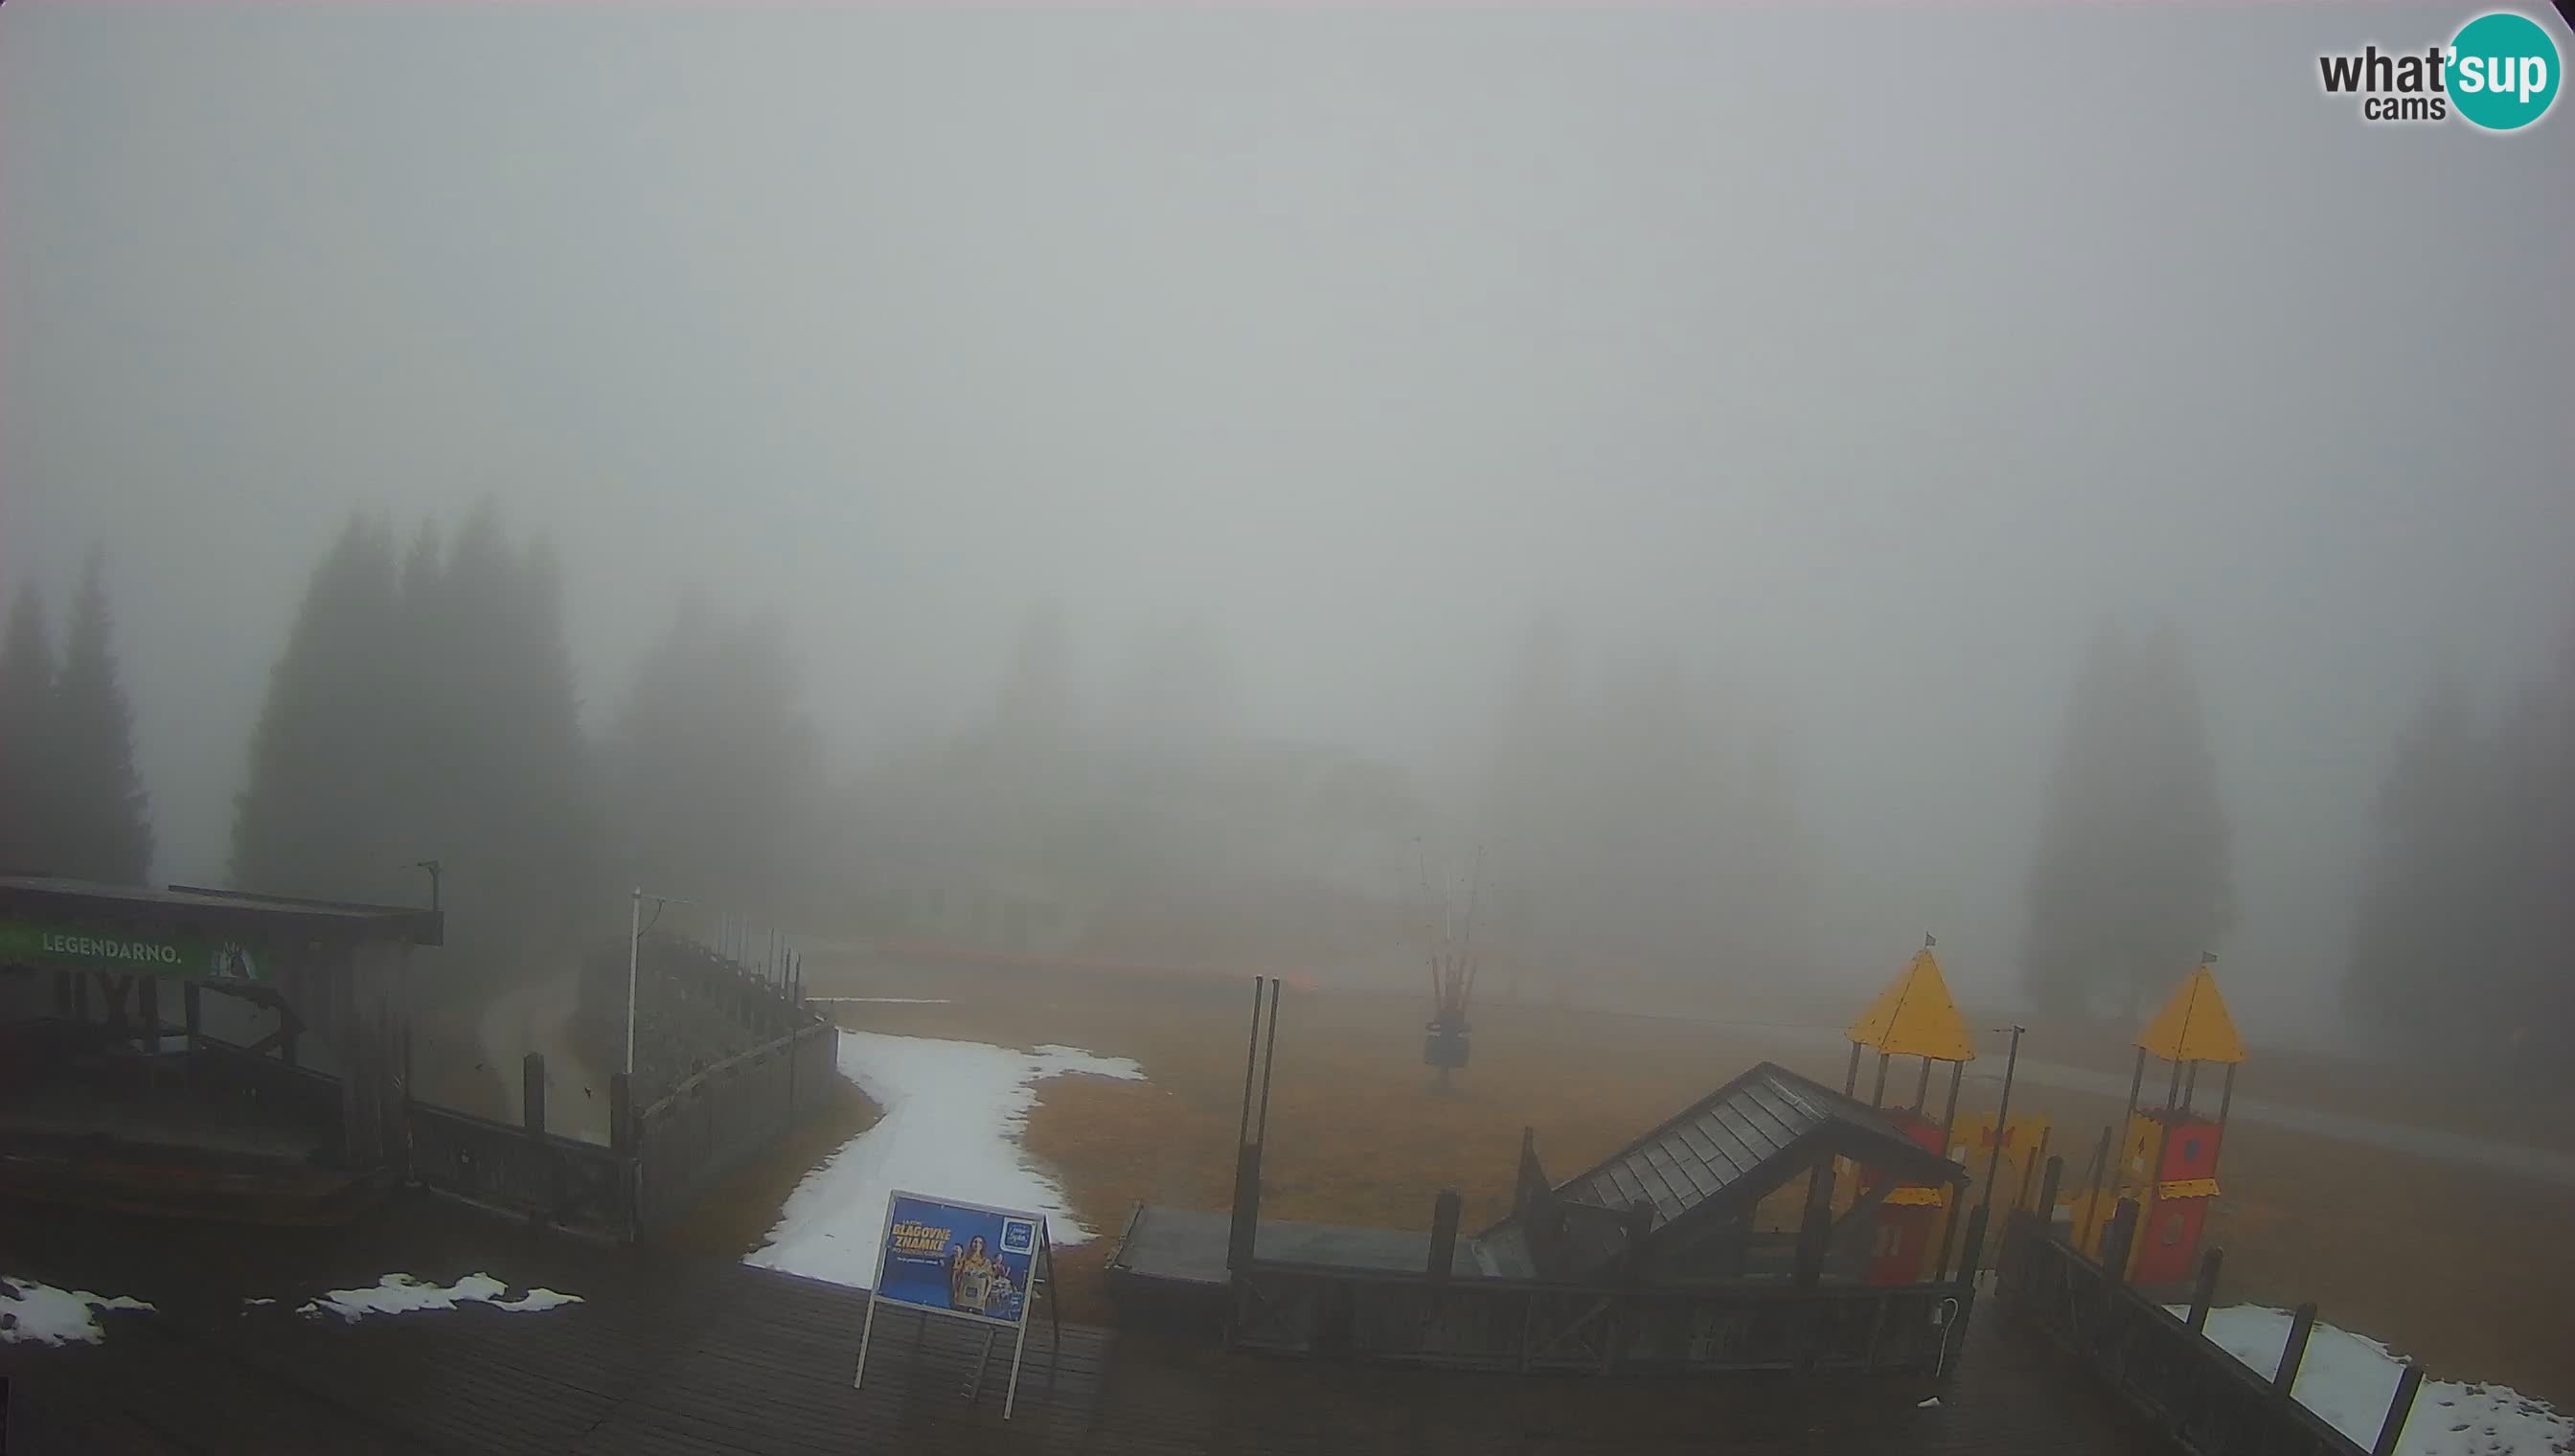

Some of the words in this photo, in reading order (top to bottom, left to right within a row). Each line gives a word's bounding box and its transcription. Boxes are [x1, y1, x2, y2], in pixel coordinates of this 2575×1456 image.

[43, 933, 182, 964] LEGENDARNO.
[892, 1224, 951, 1240] BLAGOVNE
[895, 1236, 946, 1251] ZNAMKE
